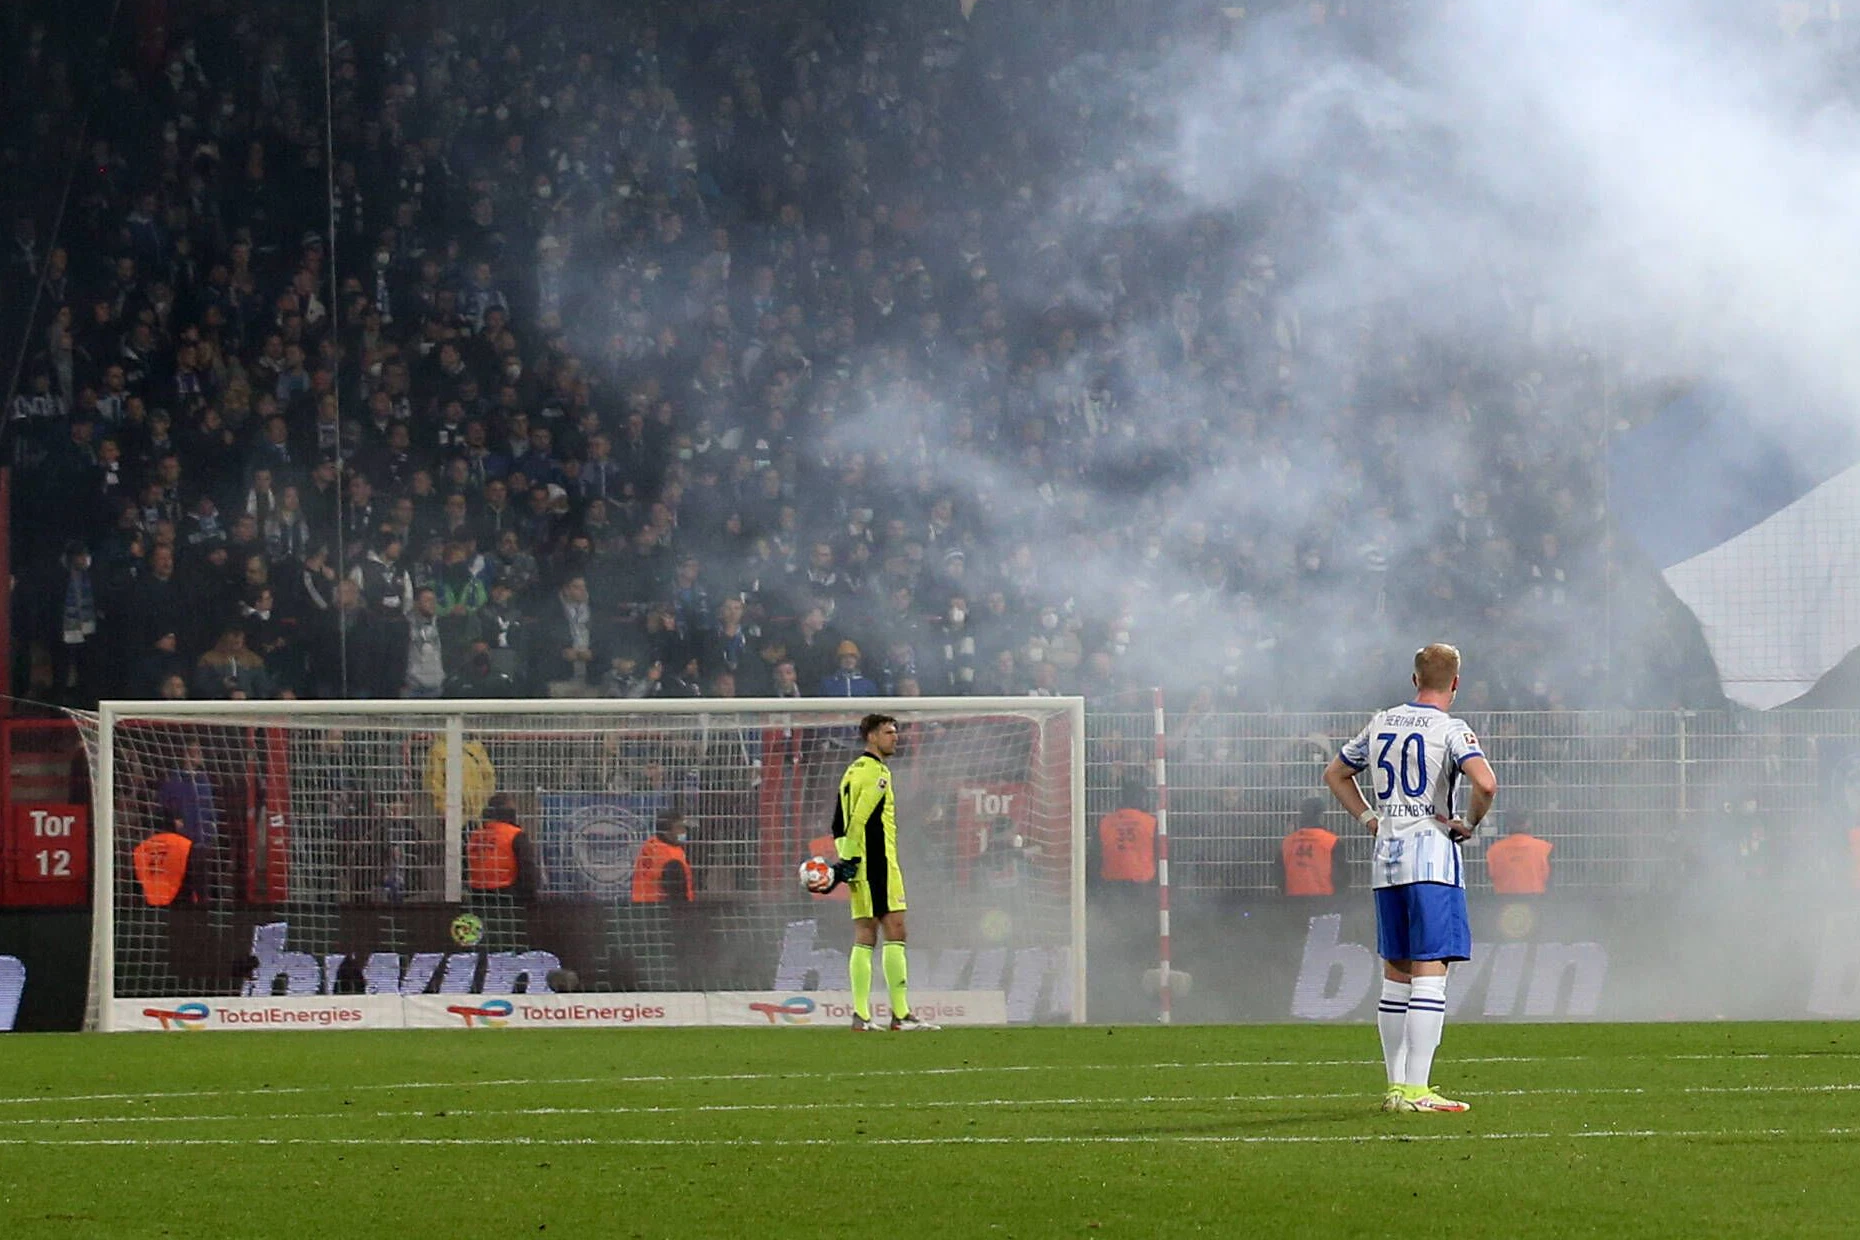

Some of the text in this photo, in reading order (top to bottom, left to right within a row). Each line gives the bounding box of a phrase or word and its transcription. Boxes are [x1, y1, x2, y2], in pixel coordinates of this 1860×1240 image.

[1377, 733, 1428, 800] 30
[972, 788, 1014, 816] Tor
[29, 810, 75, 838] Tor
[36, 849, 71, 877] 12
[218, 1007, 363, 1027] TotalEnergies
[521, 1004, 666, 1024] TotalEnergies
